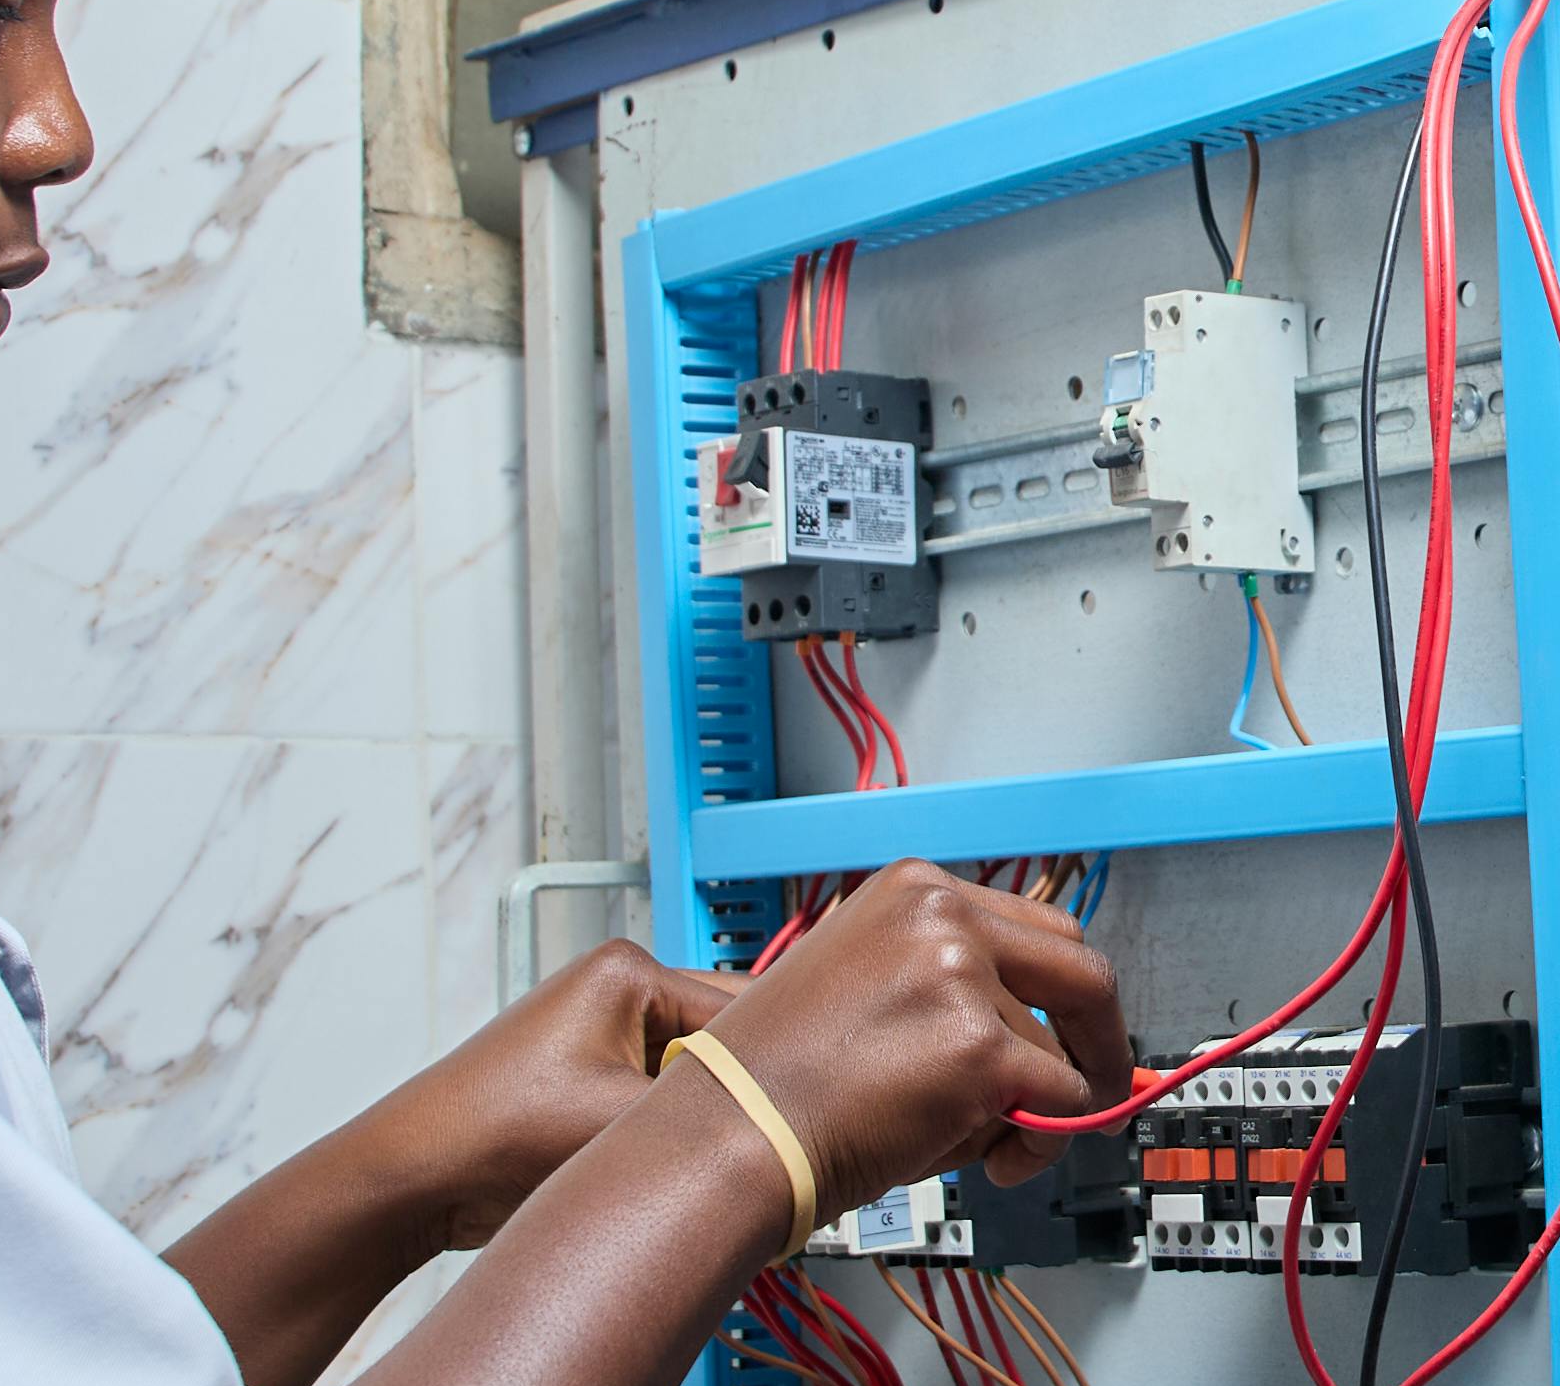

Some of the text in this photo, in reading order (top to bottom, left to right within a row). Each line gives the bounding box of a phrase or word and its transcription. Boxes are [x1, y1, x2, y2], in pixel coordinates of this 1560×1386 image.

[1137, 1121, 1151, 1132] CA2
[1241, 1121, 1256, 1131] CA2
[1138, 1133, 1156, 1144] DN22
[1241, 1133, 1260, 1143] DN22
